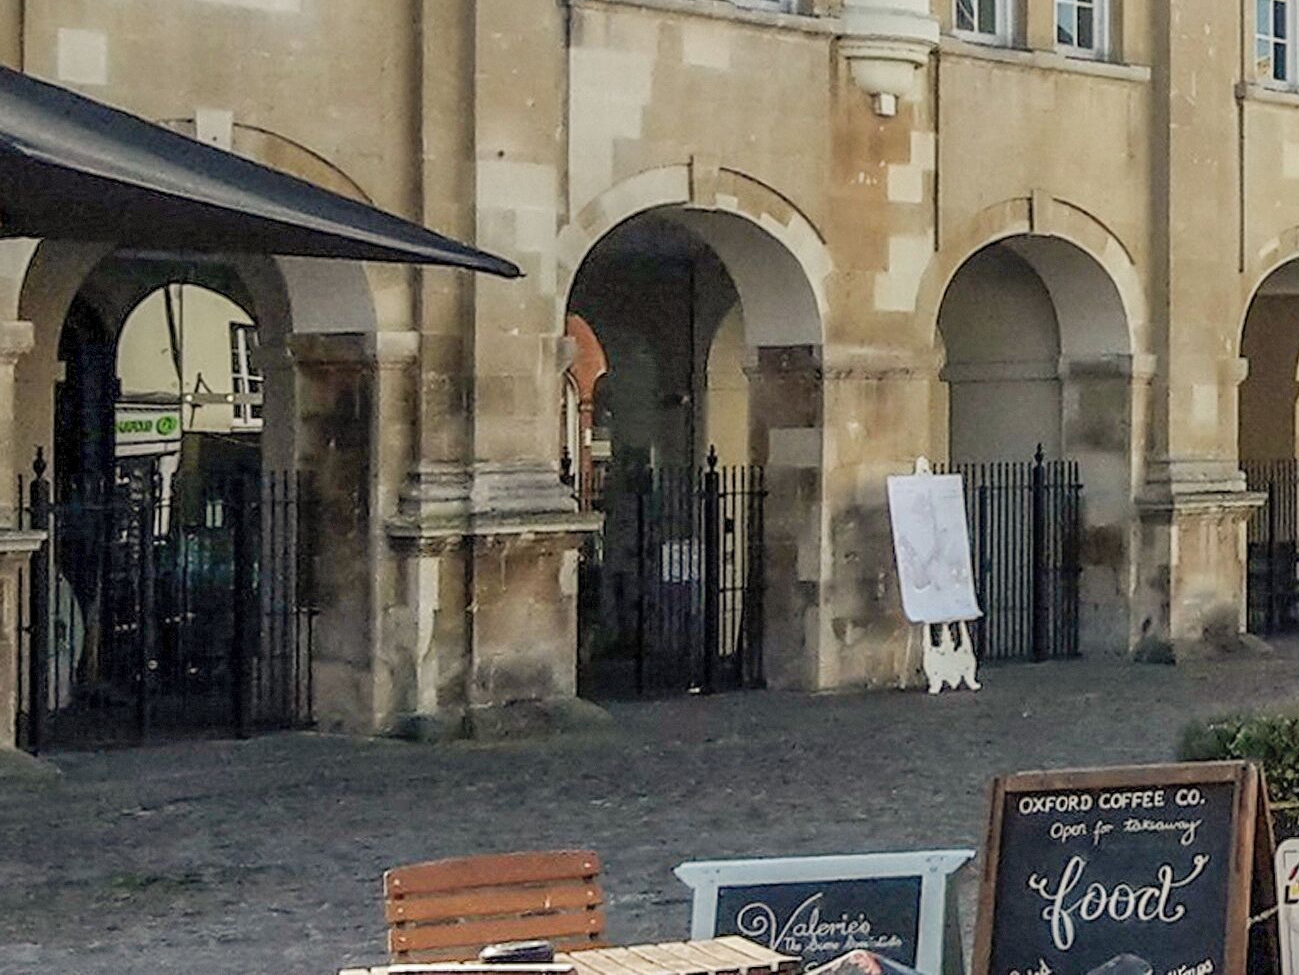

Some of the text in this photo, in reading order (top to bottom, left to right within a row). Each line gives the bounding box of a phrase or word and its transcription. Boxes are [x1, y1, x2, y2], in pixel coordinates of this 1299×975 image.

[1018, 787, 1206, 815] OXFORD COFFEE CO.
[1050, 822, 1087, 844] Open
[1092, 820, 1115, 846] for
[737, 891, 871, 952] Valerie's
[1028, 853, 1210, 951] food
